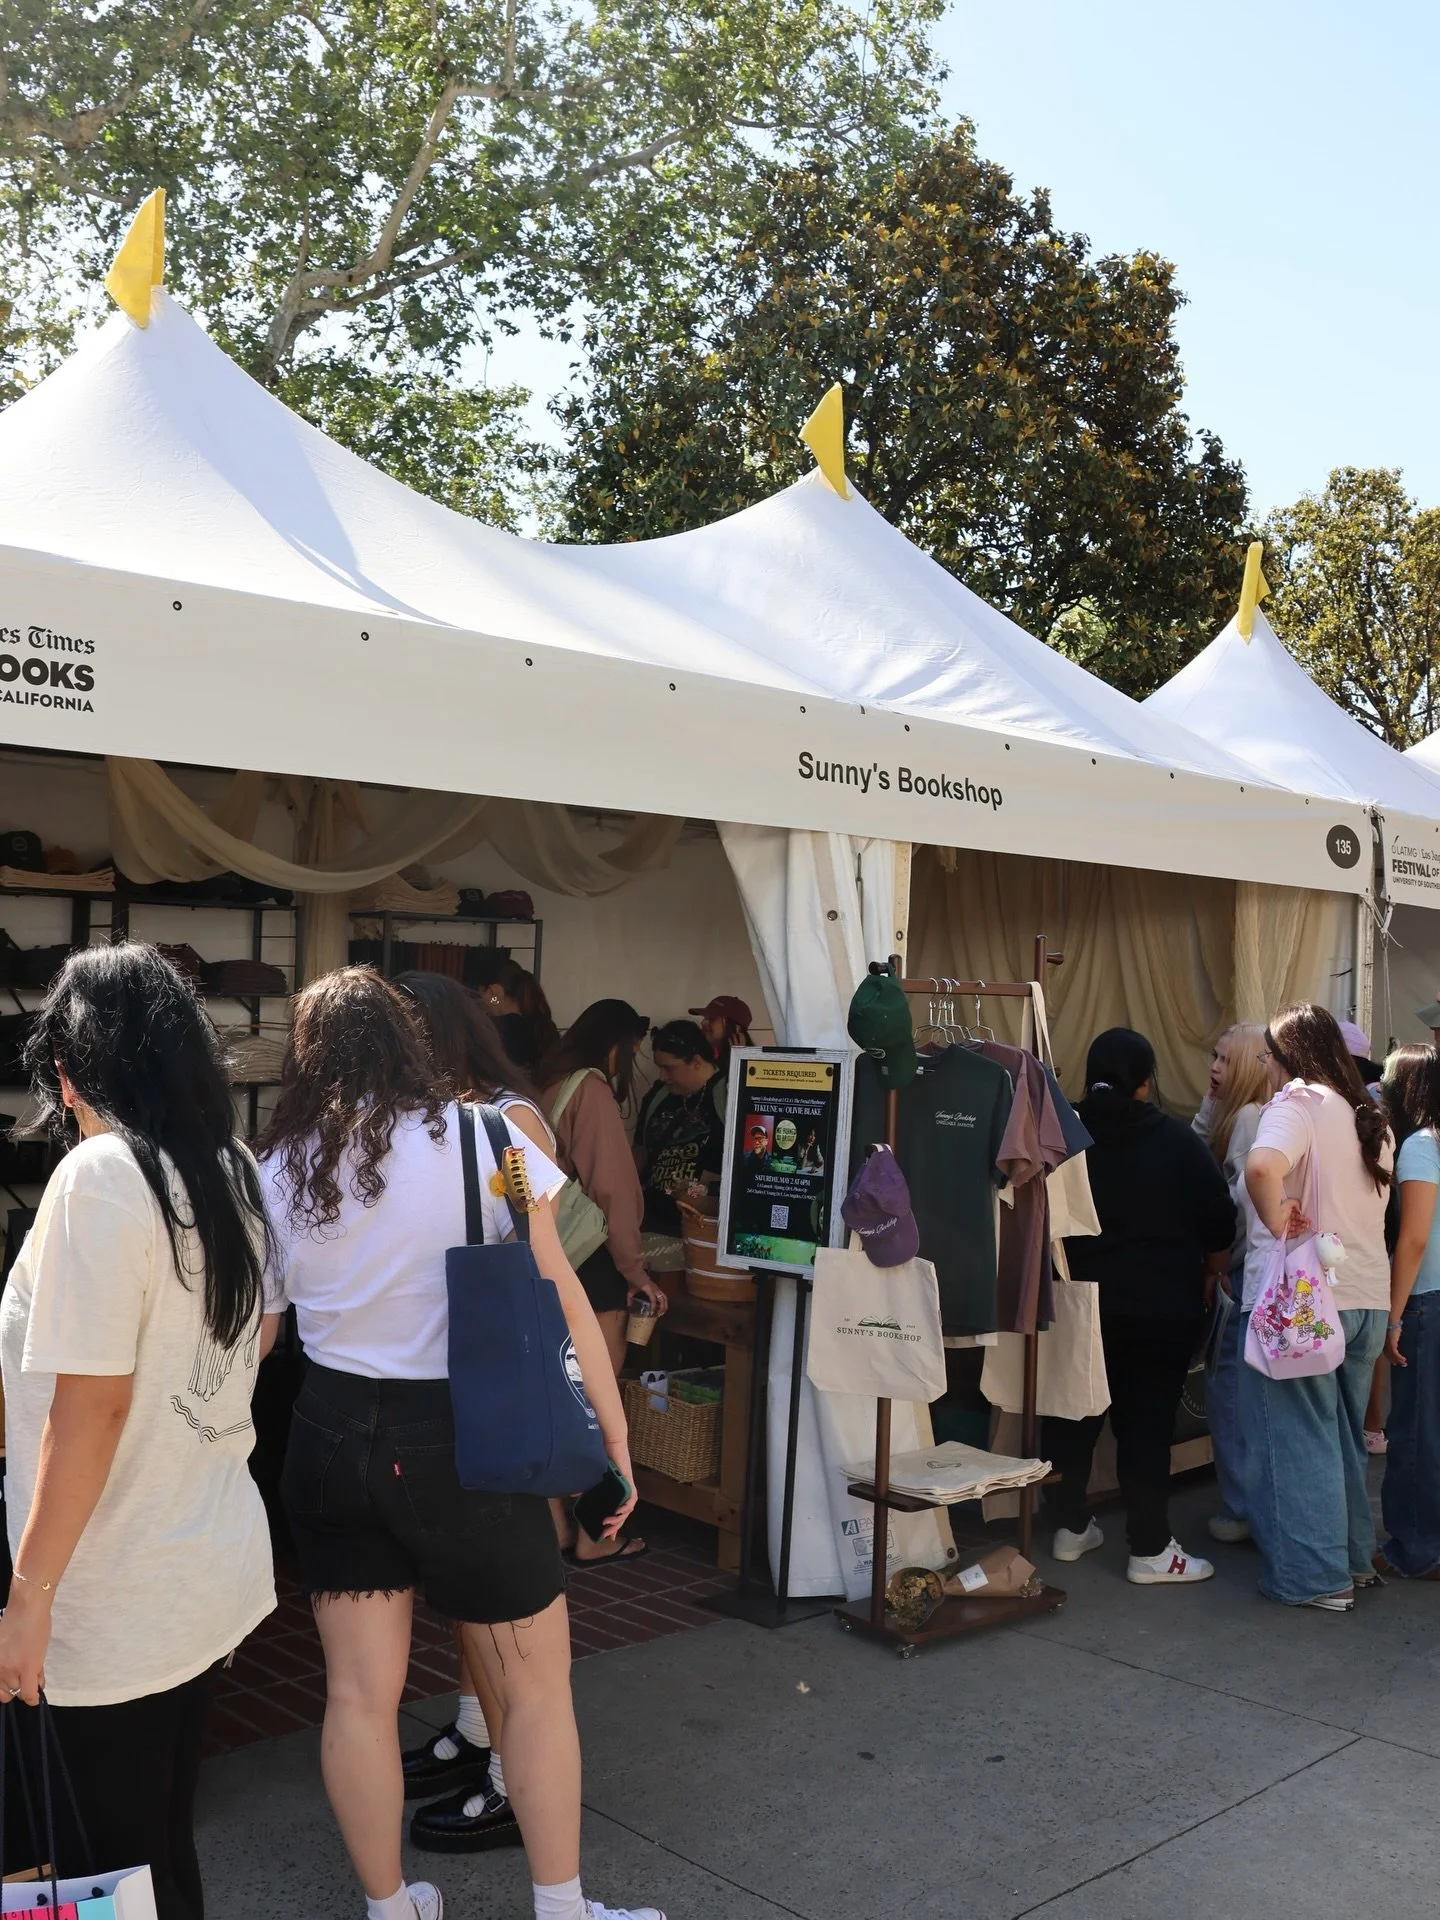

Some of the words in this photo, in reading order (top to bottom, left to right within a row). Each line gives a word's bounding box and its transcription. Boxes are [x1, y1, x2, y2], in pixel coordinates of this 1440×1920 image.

[27, 625, 96, 655] Times
[0, 689, 95, 713] ALIFORNIA
[798, 751, 890, 794] Sunny's
[898, 766, 1003, 811] Bookshop
[1335, 838, 1352, 855] 135
[1392, 858, 1431, 878] FESTIVAL
[763, 1069, 786, 1077] TICKETS
[786, 1070, 817, 1078] REQUIRED
[836, 1326, 874, 1337] SUNNY'S
[877, 1330, 922, 1342] BOOKSHOP
